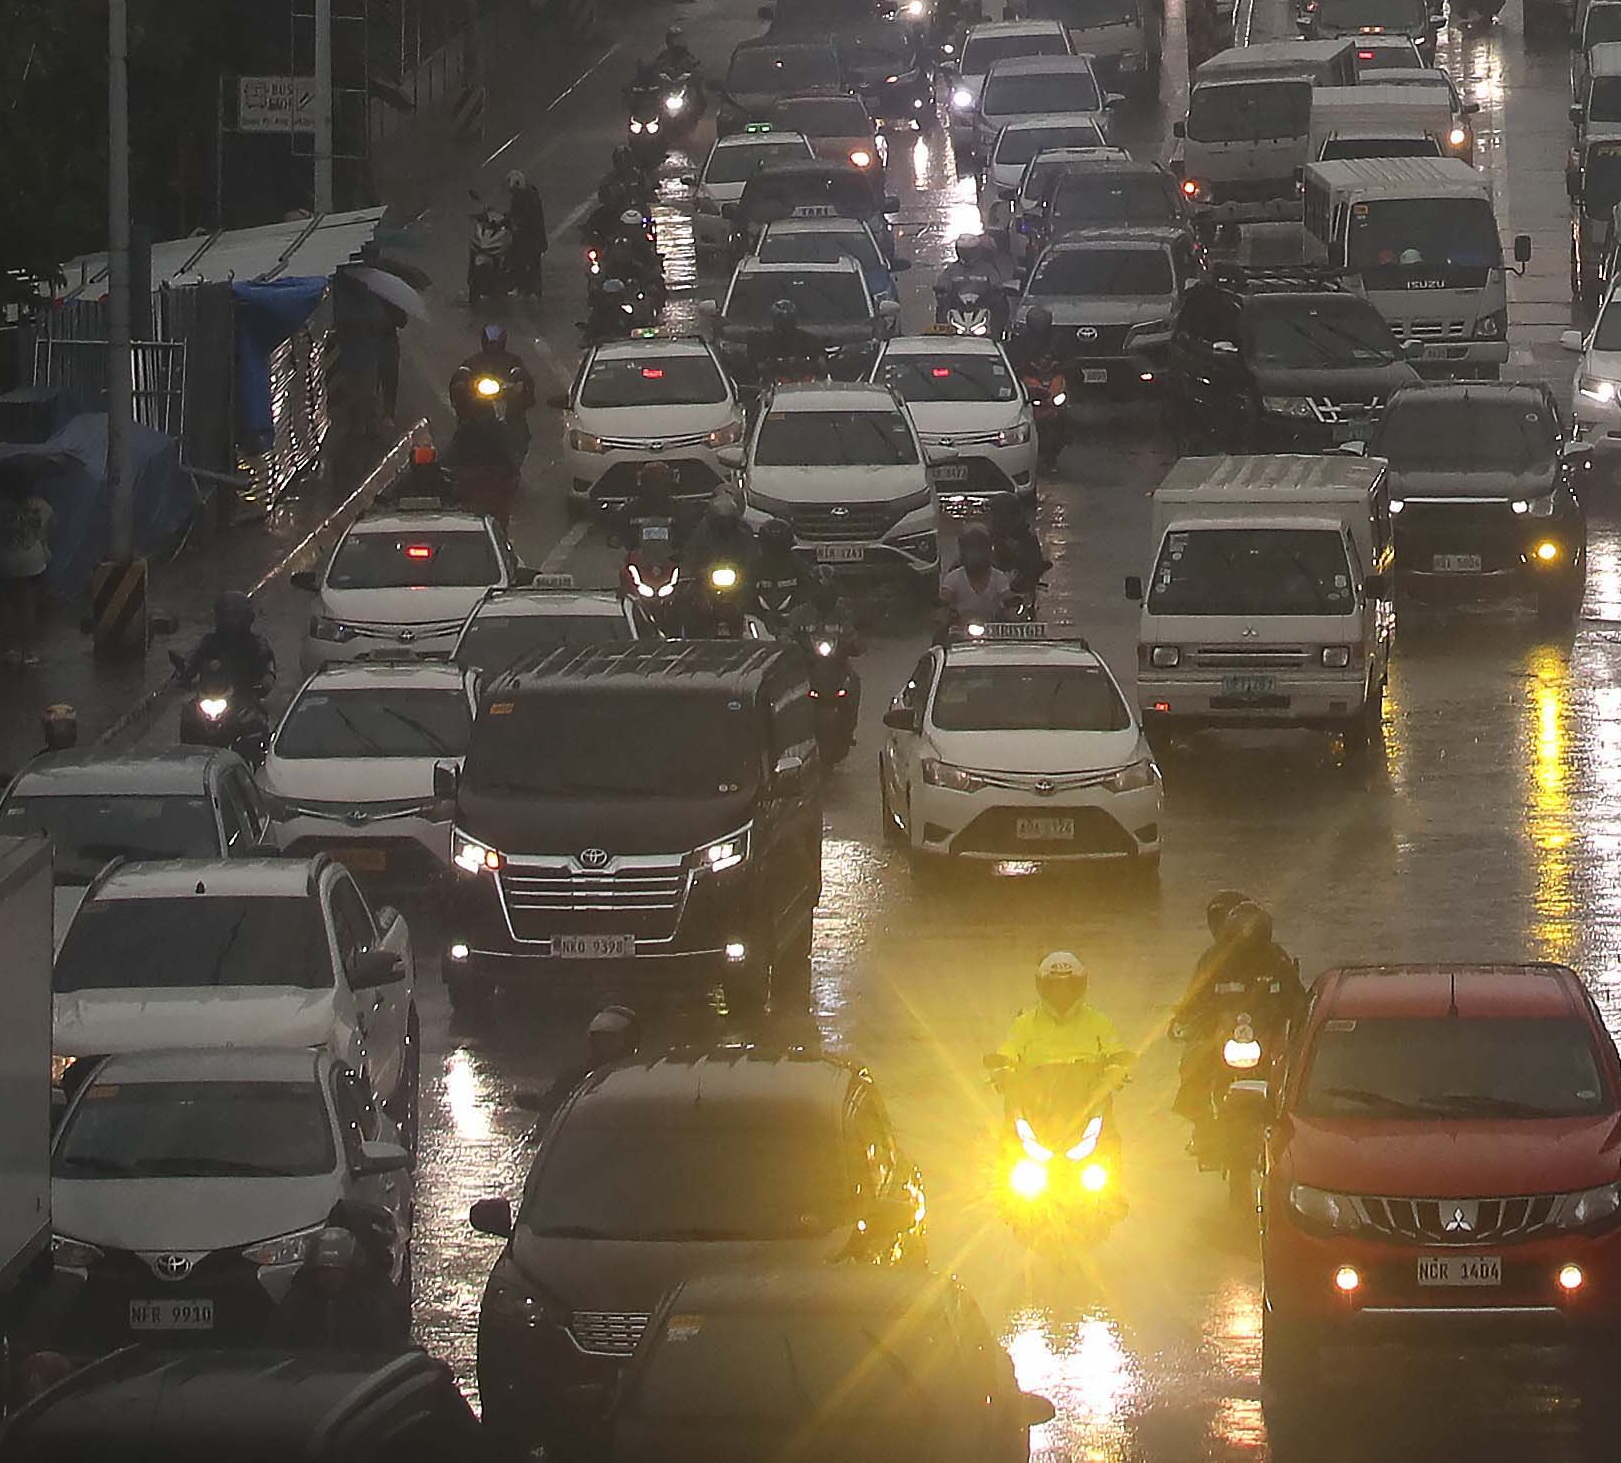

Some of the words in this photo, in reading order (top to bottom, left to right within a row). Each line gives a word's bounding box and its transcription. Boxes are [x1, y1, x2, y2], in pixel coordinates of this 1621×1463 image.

[1407, 279, 1445, 289] ISUZU
[1418, 1263, 1449, 1279] NCR
[1460, 1263, 1500, 1279] 1404
